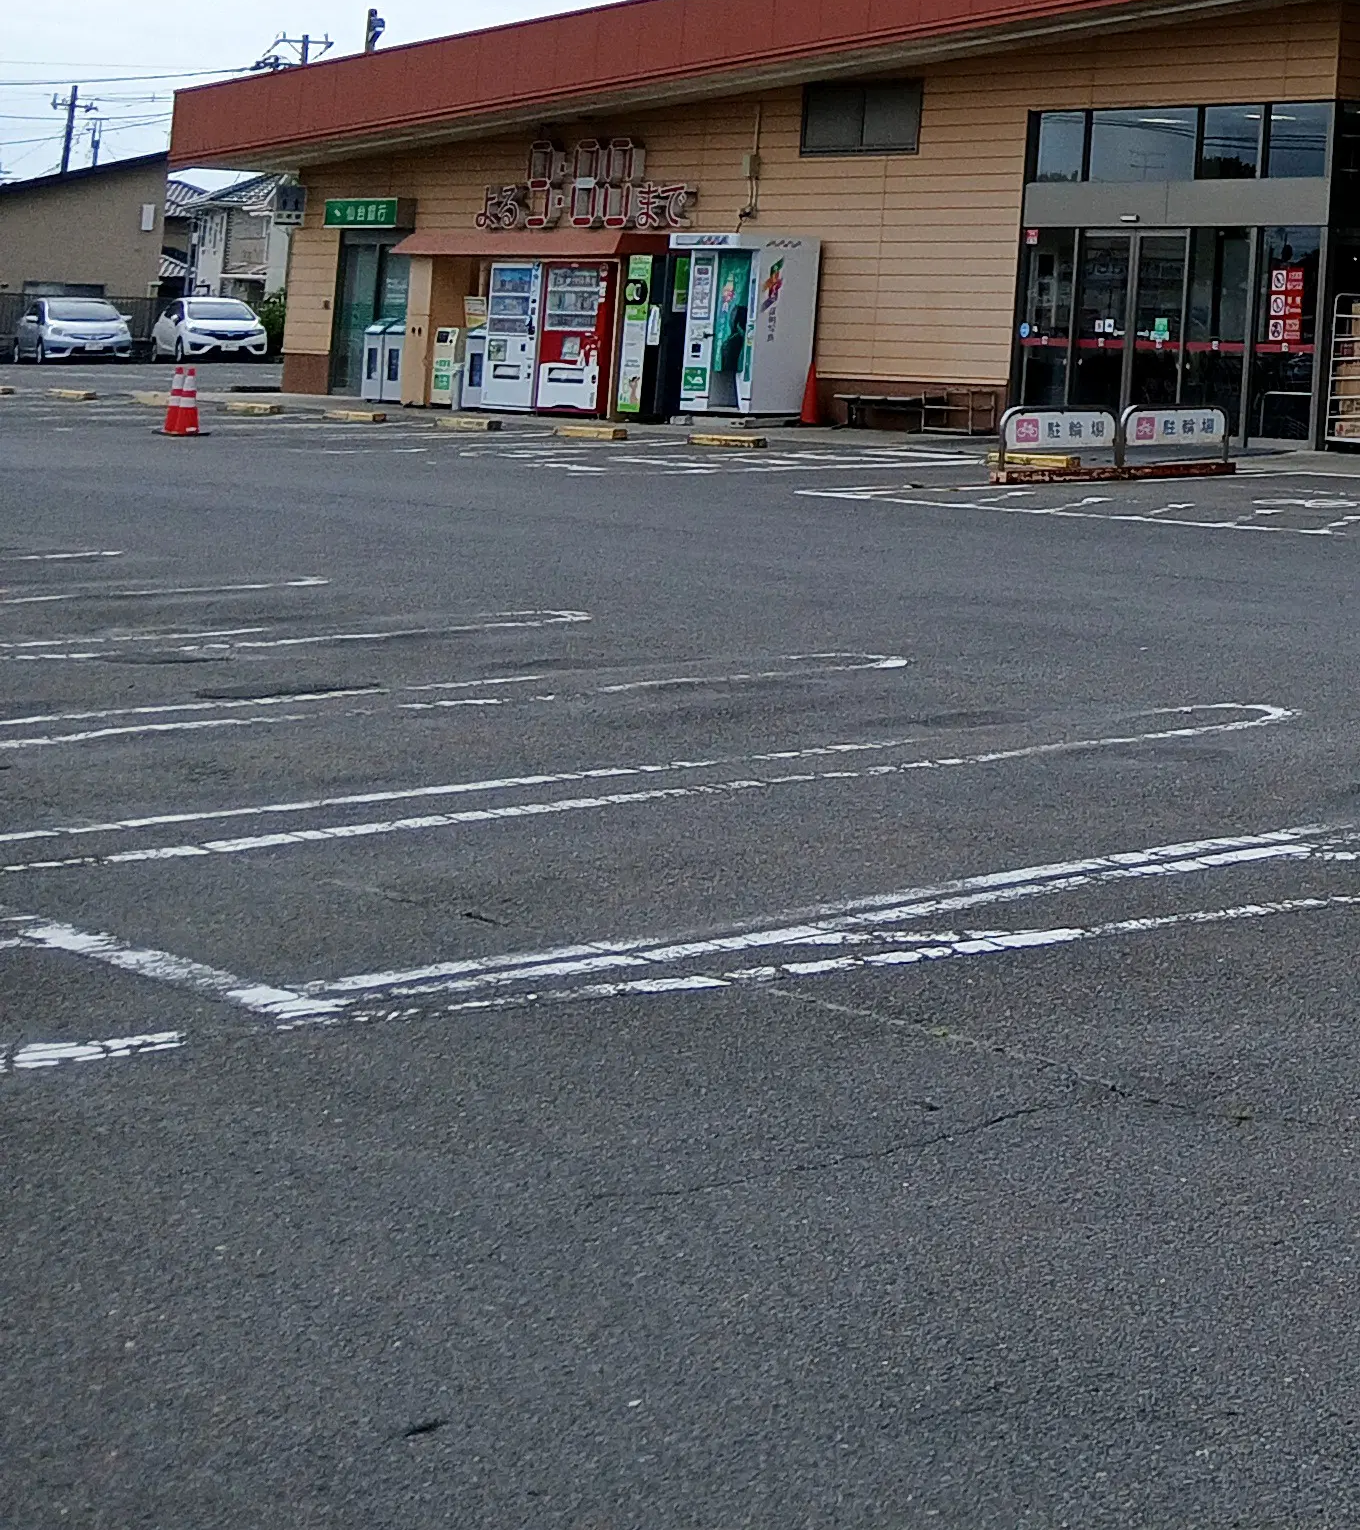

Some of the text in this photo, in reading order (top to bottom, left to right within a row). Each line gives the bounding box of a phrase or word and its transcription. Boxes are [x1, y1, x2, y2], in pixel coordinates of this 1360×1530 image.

[345, 204, 387, 222] 仙台銀行
[1046, 420, 1105, 439] 駐輪場
[1162, 417, 1216, 436] 駐輪場
